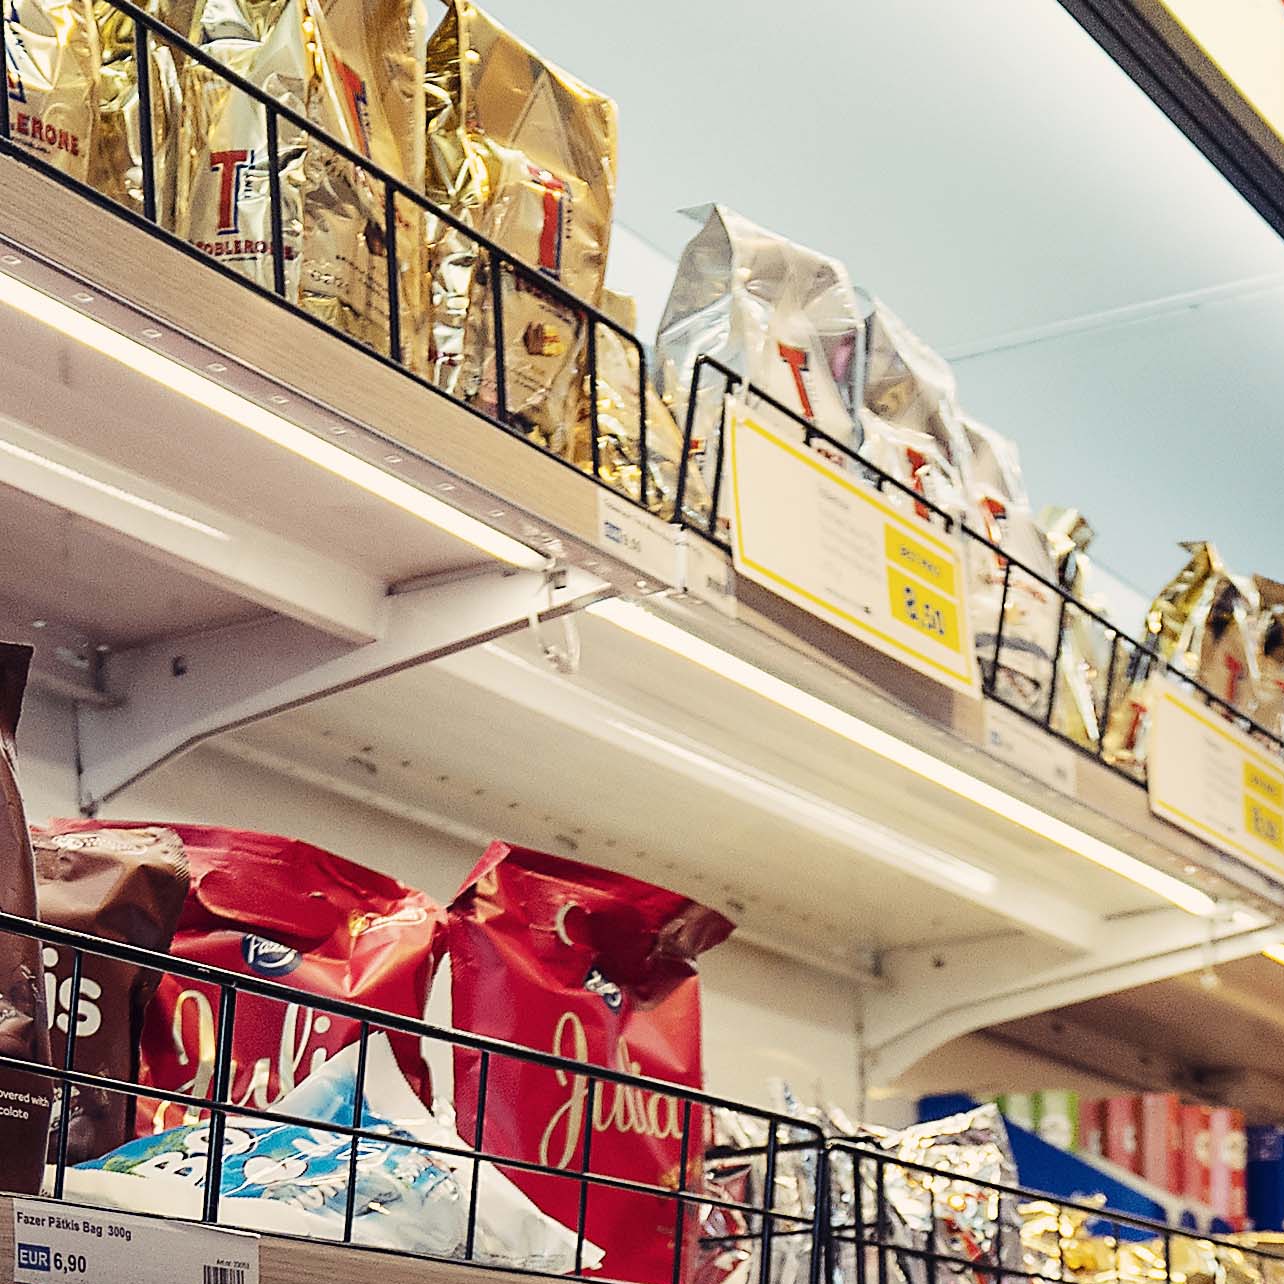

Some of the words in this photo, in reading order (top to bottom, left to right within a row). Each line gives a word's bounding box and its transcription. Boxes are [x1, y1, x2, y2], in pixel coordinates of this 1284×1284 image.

[539, 1012, 685, 1160] Julia
[17, 1211, 46, 1228] Fazer
[83, 1221, 103, 1237] Bag
[107, 1225, 132, 1242] 300g
[19, 1249, 49, 1267] EUR
[53, 1252, 87, 1274] 6,90
